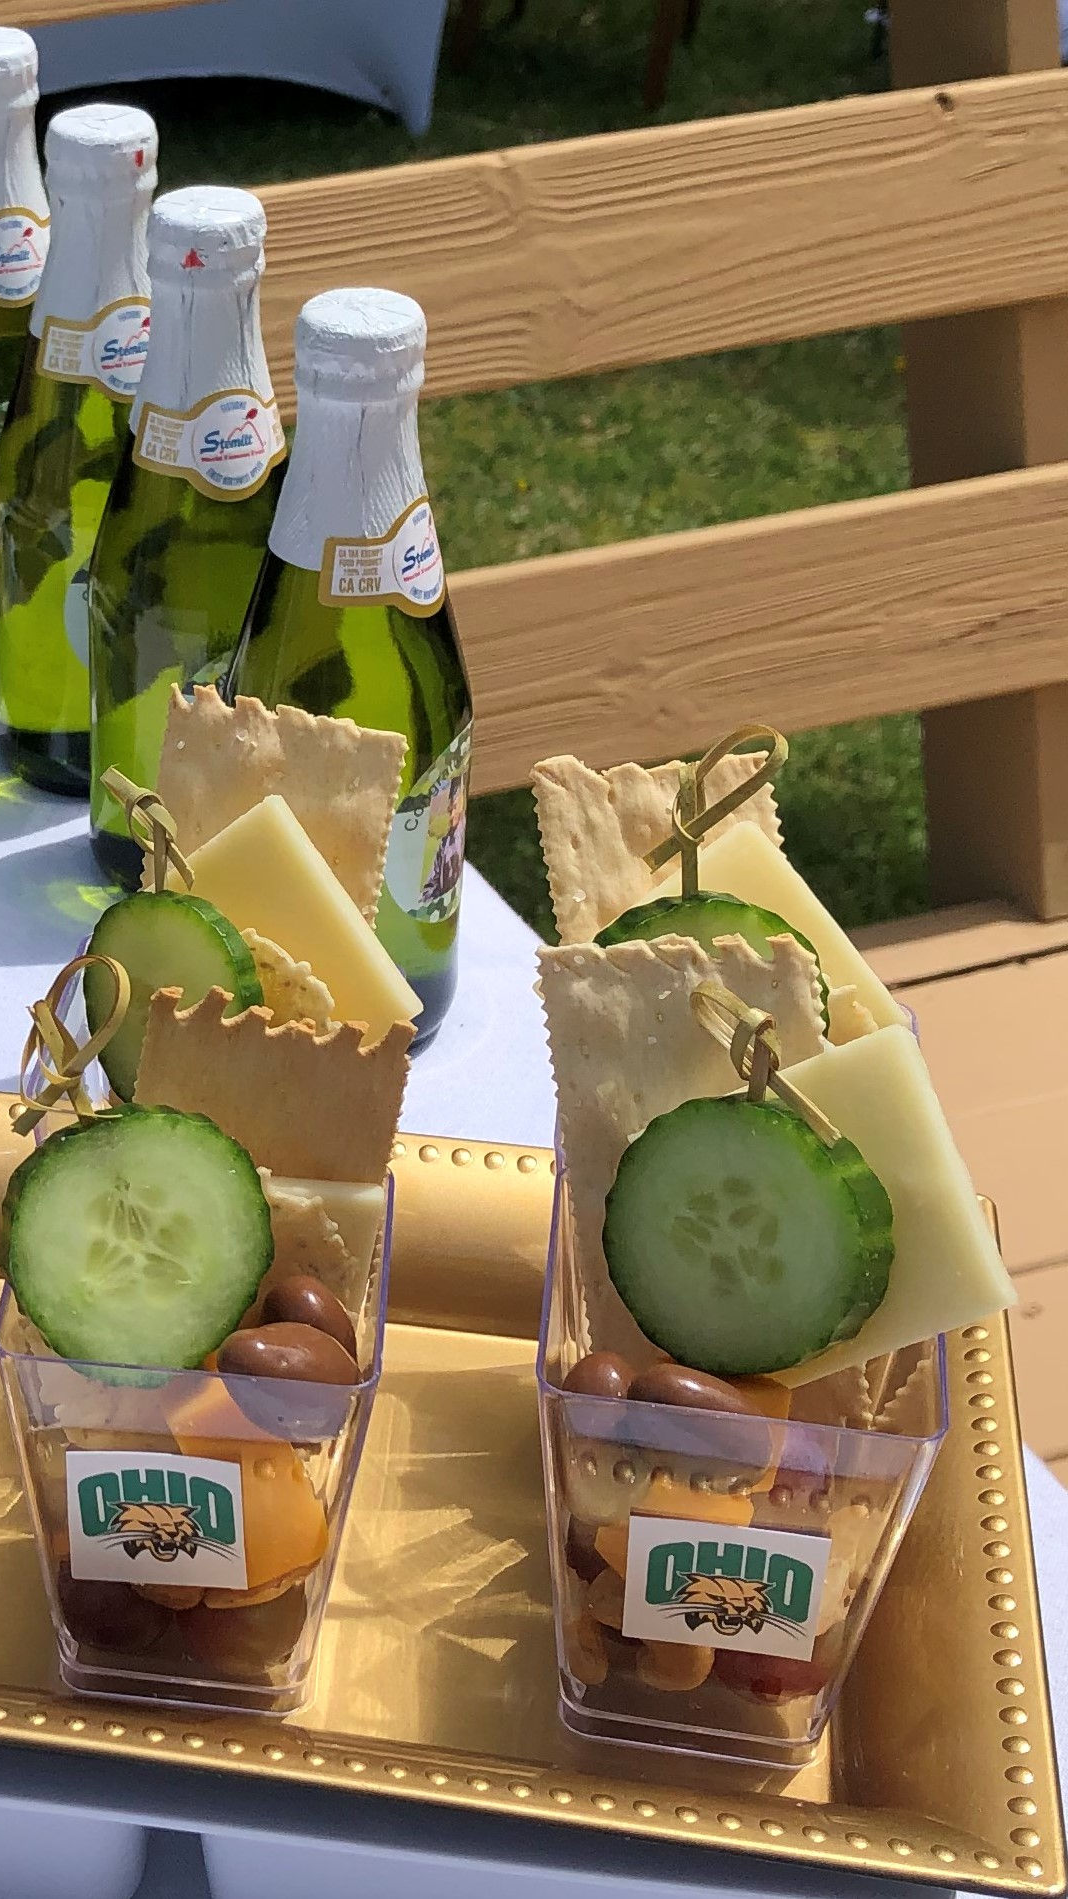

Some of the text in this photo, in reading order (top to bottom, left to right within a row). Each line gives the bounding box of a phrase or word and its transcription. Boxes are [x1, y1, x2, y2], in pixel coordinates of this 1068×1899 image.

[146, 442, 179, 463] CA CRV
[200, 430, 253, 455] Stemilt
[338, 577, 381, 593] CA CRV
[78, 1468, 236, 1545] OHIO
[645, 1541, 814, 1624] OHIO
